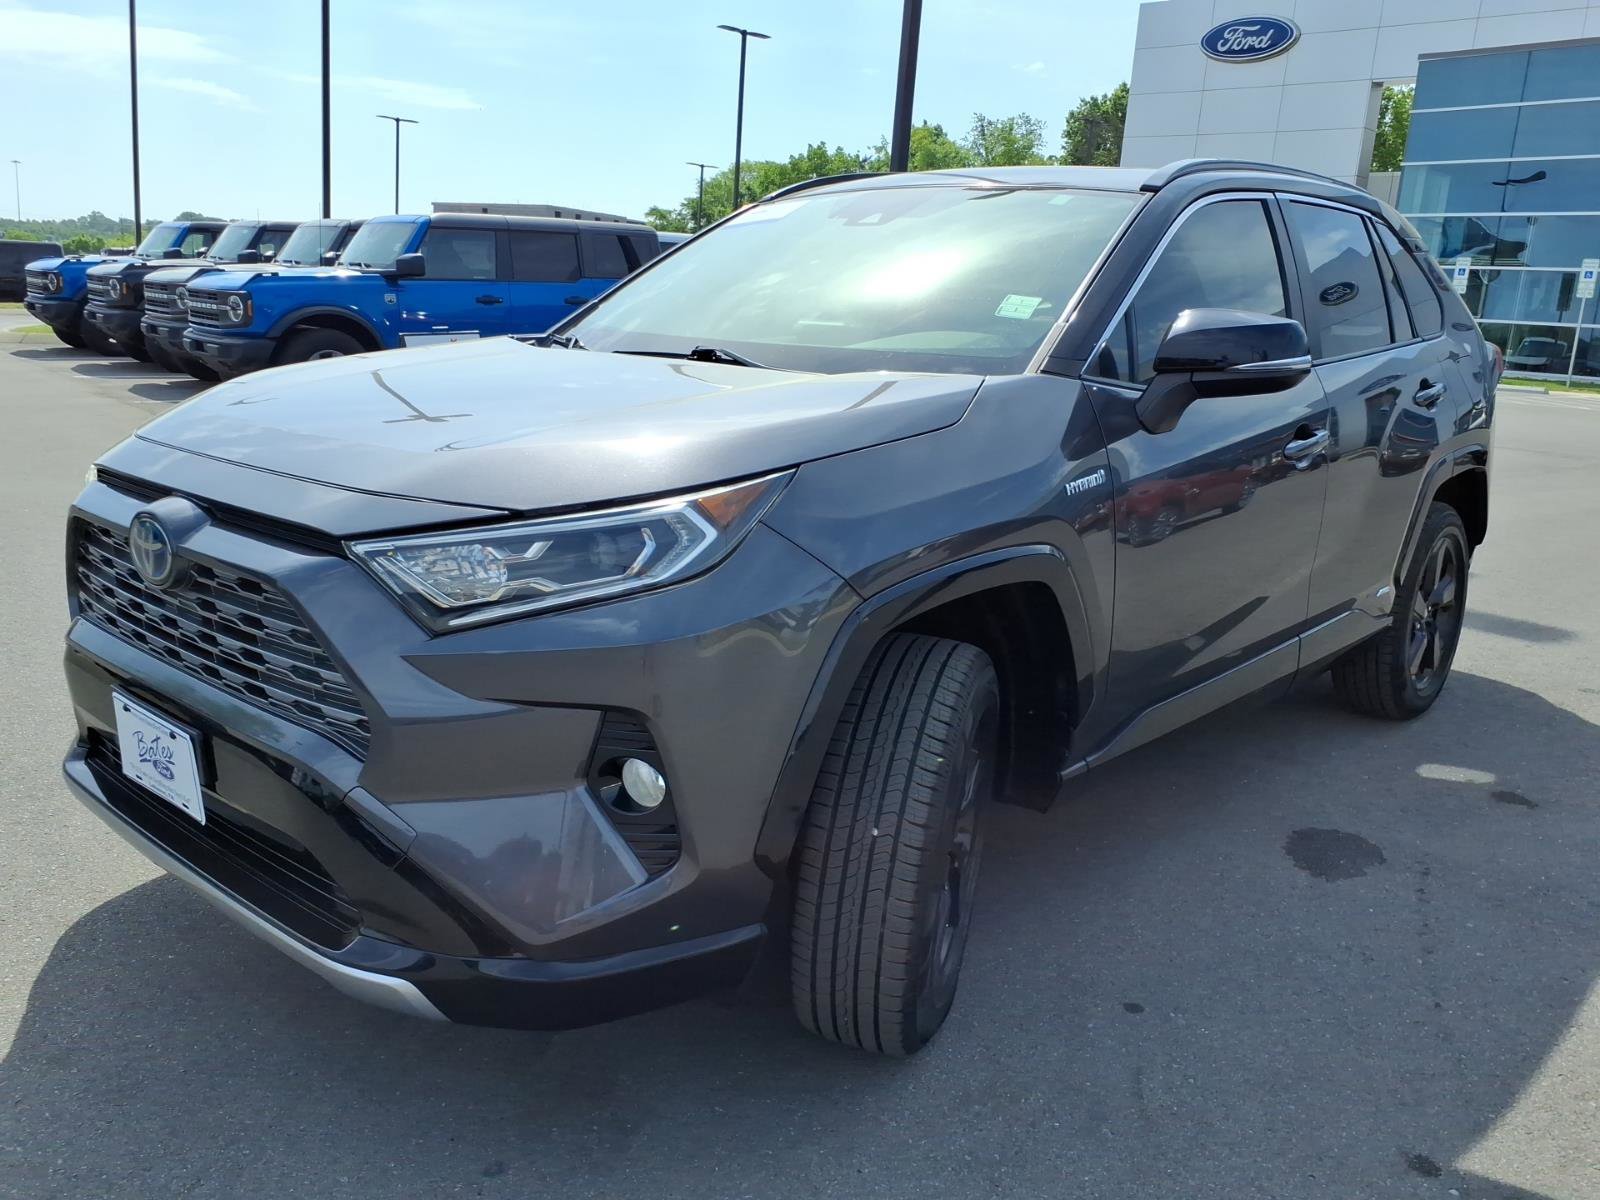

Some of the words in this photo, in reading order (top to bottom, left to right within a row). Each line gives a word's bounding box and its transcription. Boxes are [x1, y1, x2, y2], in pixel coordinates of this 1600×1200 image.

[1217, 25, 1274, 52] Ford
[1065, 468, 1105, 496] HYBRID
[132, 730, 174, 760] Bates
